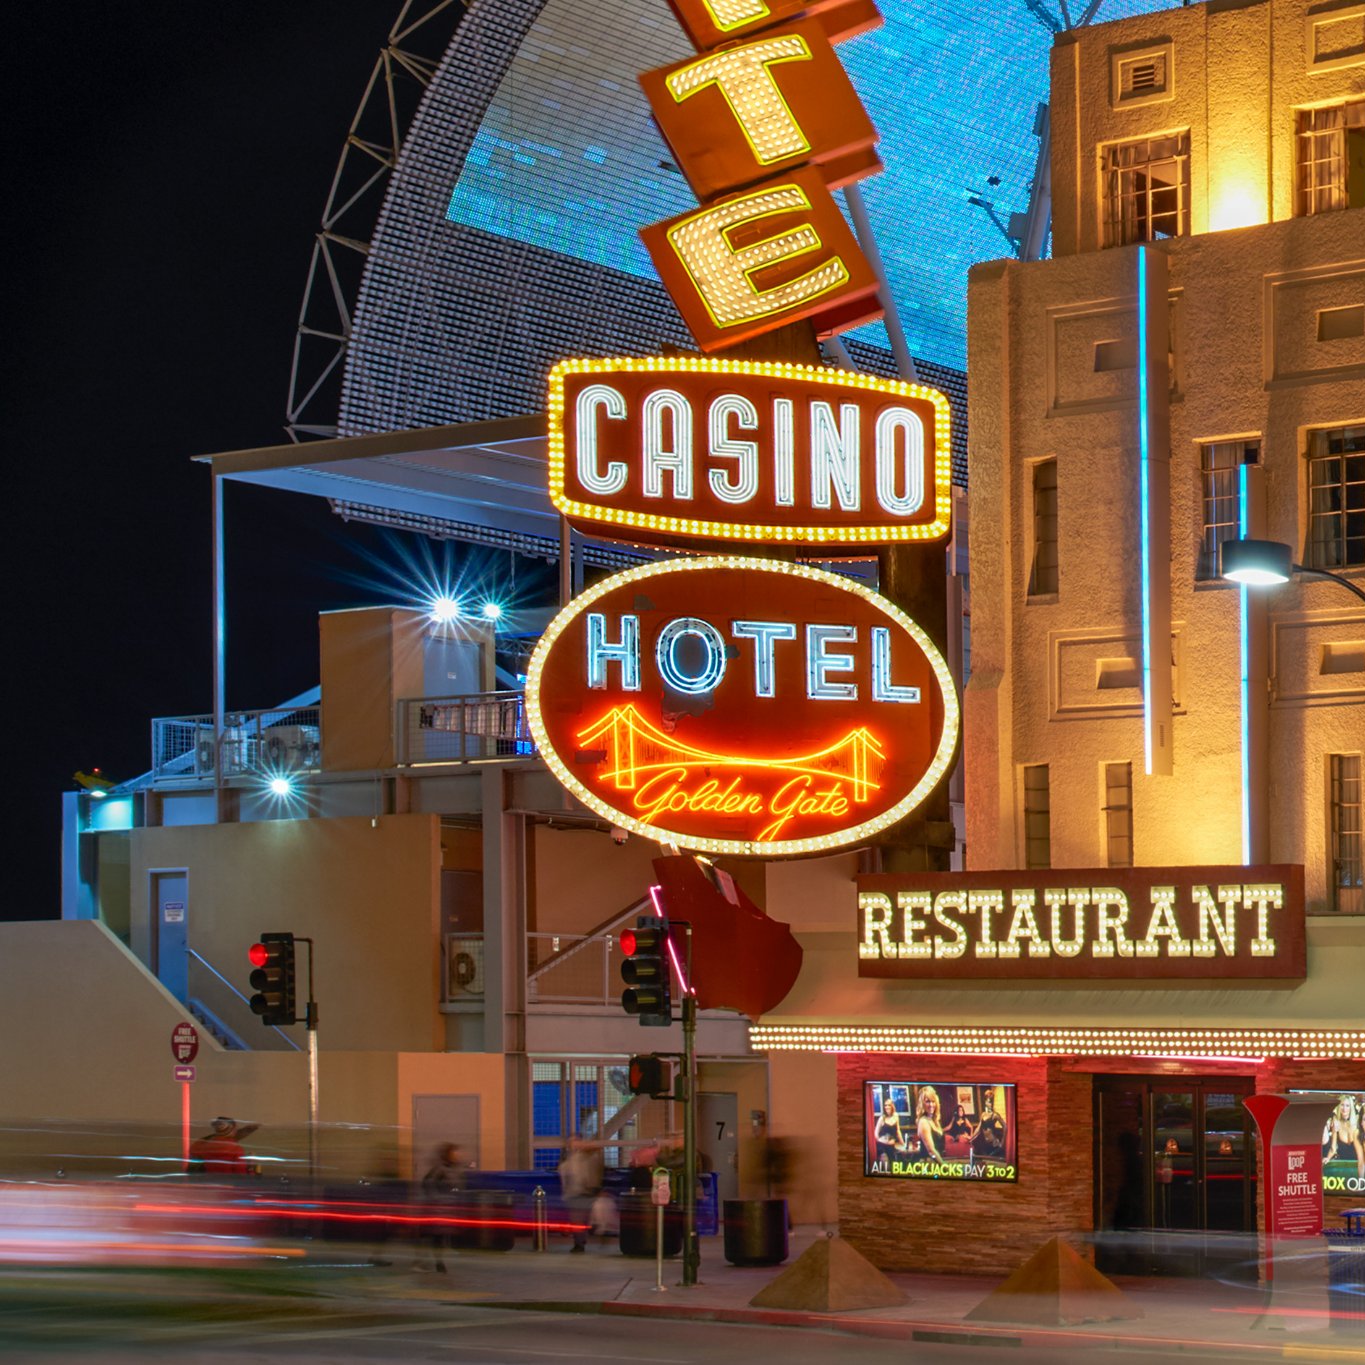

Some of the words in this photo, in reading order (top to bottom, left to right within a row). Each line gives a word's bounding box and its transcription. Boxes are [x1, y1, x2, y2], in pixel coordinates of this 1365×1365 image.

[666, 0, 849, 328] TE
[576, 384, 924, 516] CASINO
[586, 613, 921, 703] HOTEL
[634, 767, 763, 823] Golden
[756, 775, 849, 841] Gate
[858, 884, 1283, 959] RESTAURANT
[716, 1121, 726, 1141] 7
[871, 1160, 891, 1174] ALL
[892, 1161, 963, 1177] BLACKJACKS
[964, 1164, 985, 1178] PAY
[1288, 1156, 1305, 1170] LOOP
[1287, 1173, 1308, 1183] FREE
[1322, 1177, 1345, 1190] 10X
[1278, 1185, 1317, 1196] SHUTTLE
